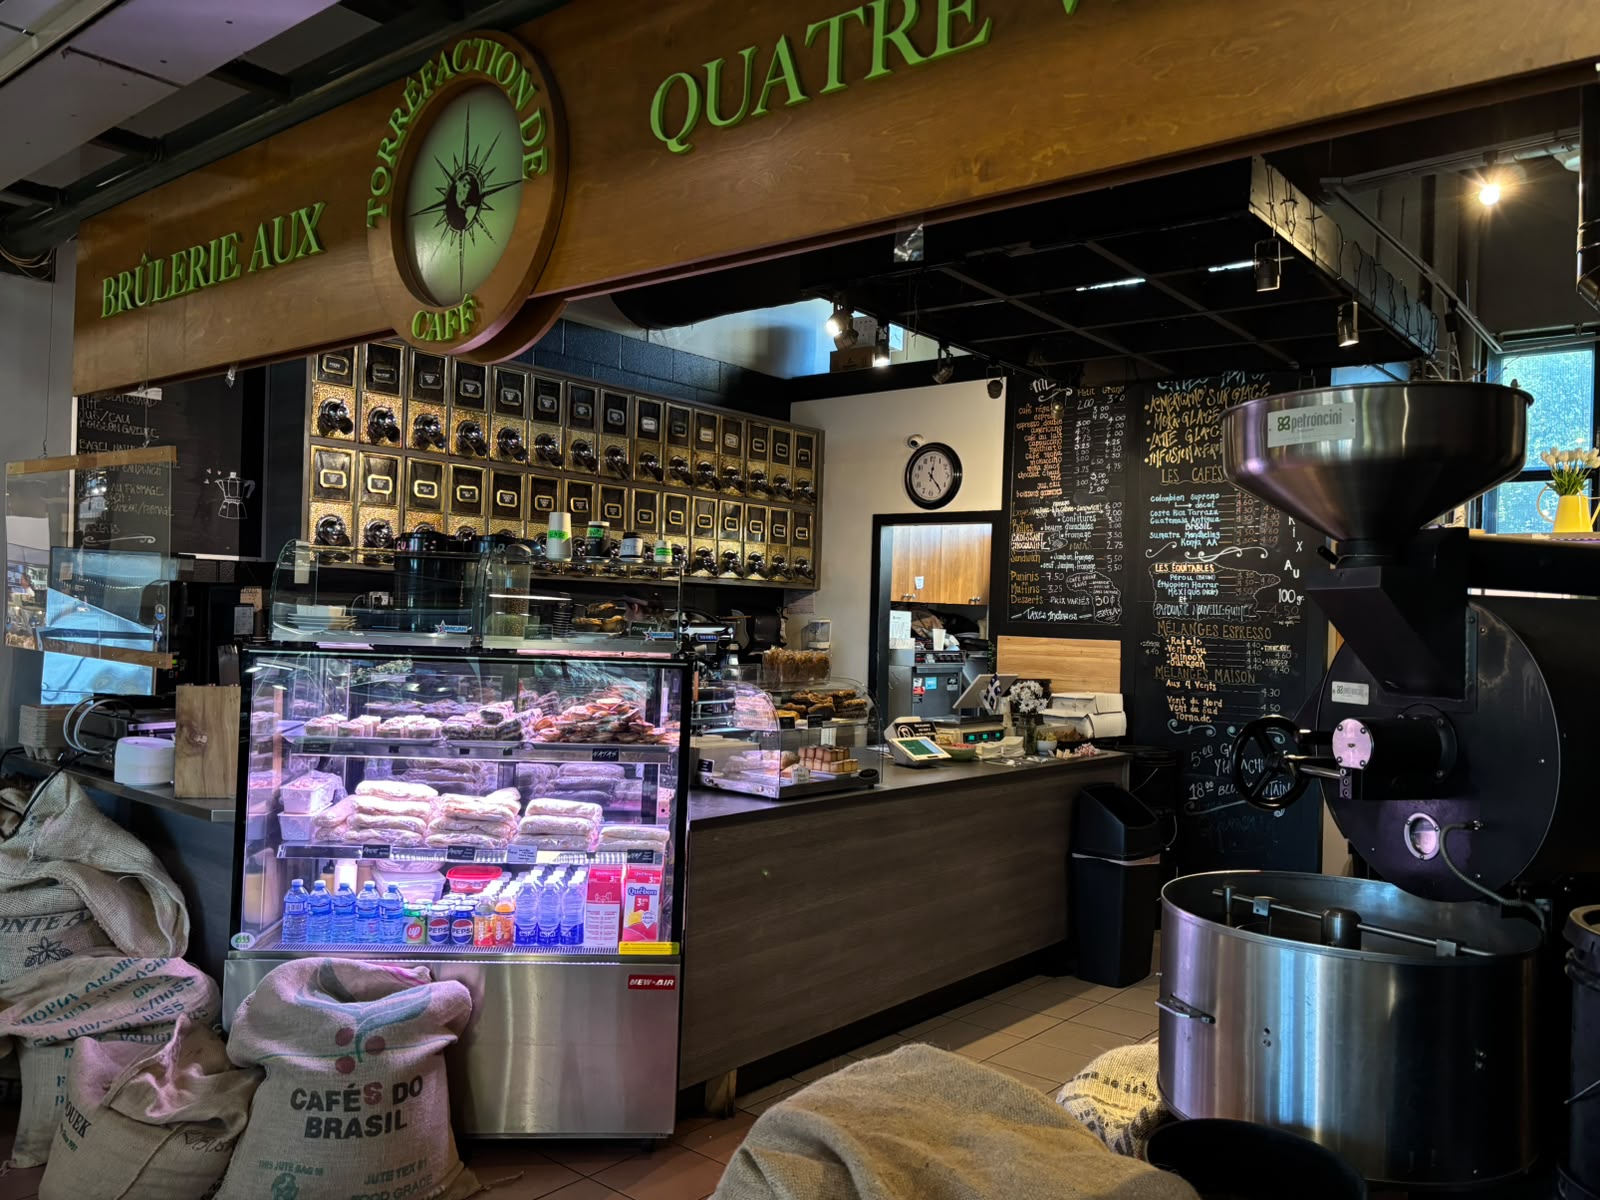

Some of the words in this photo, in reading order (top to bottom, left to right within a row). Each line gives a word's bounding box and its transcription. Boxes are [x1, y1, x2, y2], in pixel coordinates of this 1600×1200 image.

[650, 0, 991, 153] QUATRE
[367, 38, 539, 229] TORRÉFACTION
[520, 108, 549, 181] DE
[100, 232, 243, 318] BRÛLERIE
[247, 202, 327, 273] AUX
[410, 294, 478, 342] CAFÉ
[1206, 387, 1231, 409] SUR
[1291, 409, 1343, 432] petroncini
[1185, 425, 1223, 444] GLAC
[1162, 468, 1180, 483] LES
[1192, 464, 1223, 481] CAFÉS
[1062, 512, 1097, 523] confitures
[1065, 531, 1092, 542] fromage
[1206, 538, 1218, 546] AA
[1010, 570, 1040, 583] Paninis
[1155, 564, 1169, 572] LES
[1172, 562, 1215, 573] ÉQUITABLES
[1010, 582, 1040, 594] Muffins
[1278, 588, 1296, 603] 100
[1010, 594, 1044, 604] Desserts
[1157, 620, 1219, 638] MÉLANGES
[1223, 624, 1272, 640] ESPRESSO
[1155, 665, 1209, 681] MÉLANGES
[1215, 669, 1256, 684] MAISON
[1166, 679, 1181, 688] Aux
[1194, 681, 1217, 692] Vents
[1166, 695, 1186, 705] Vent
[1203, 698, 1223, 708] Nord
[1169, 704, 1188, 713] Vent
[428, 926, 449, 934] PEPSI
[290, 1081, 384, 1113] CAFÉS
[392, 1075, 424, 1105] DO
[304, 1110, 408, 1140] BRASIL
[274, 1161, 294, 1171] JUTE
[364, 1168, 395, 1186] JUTE
[393, 1173, 433, 1198] GRADE
